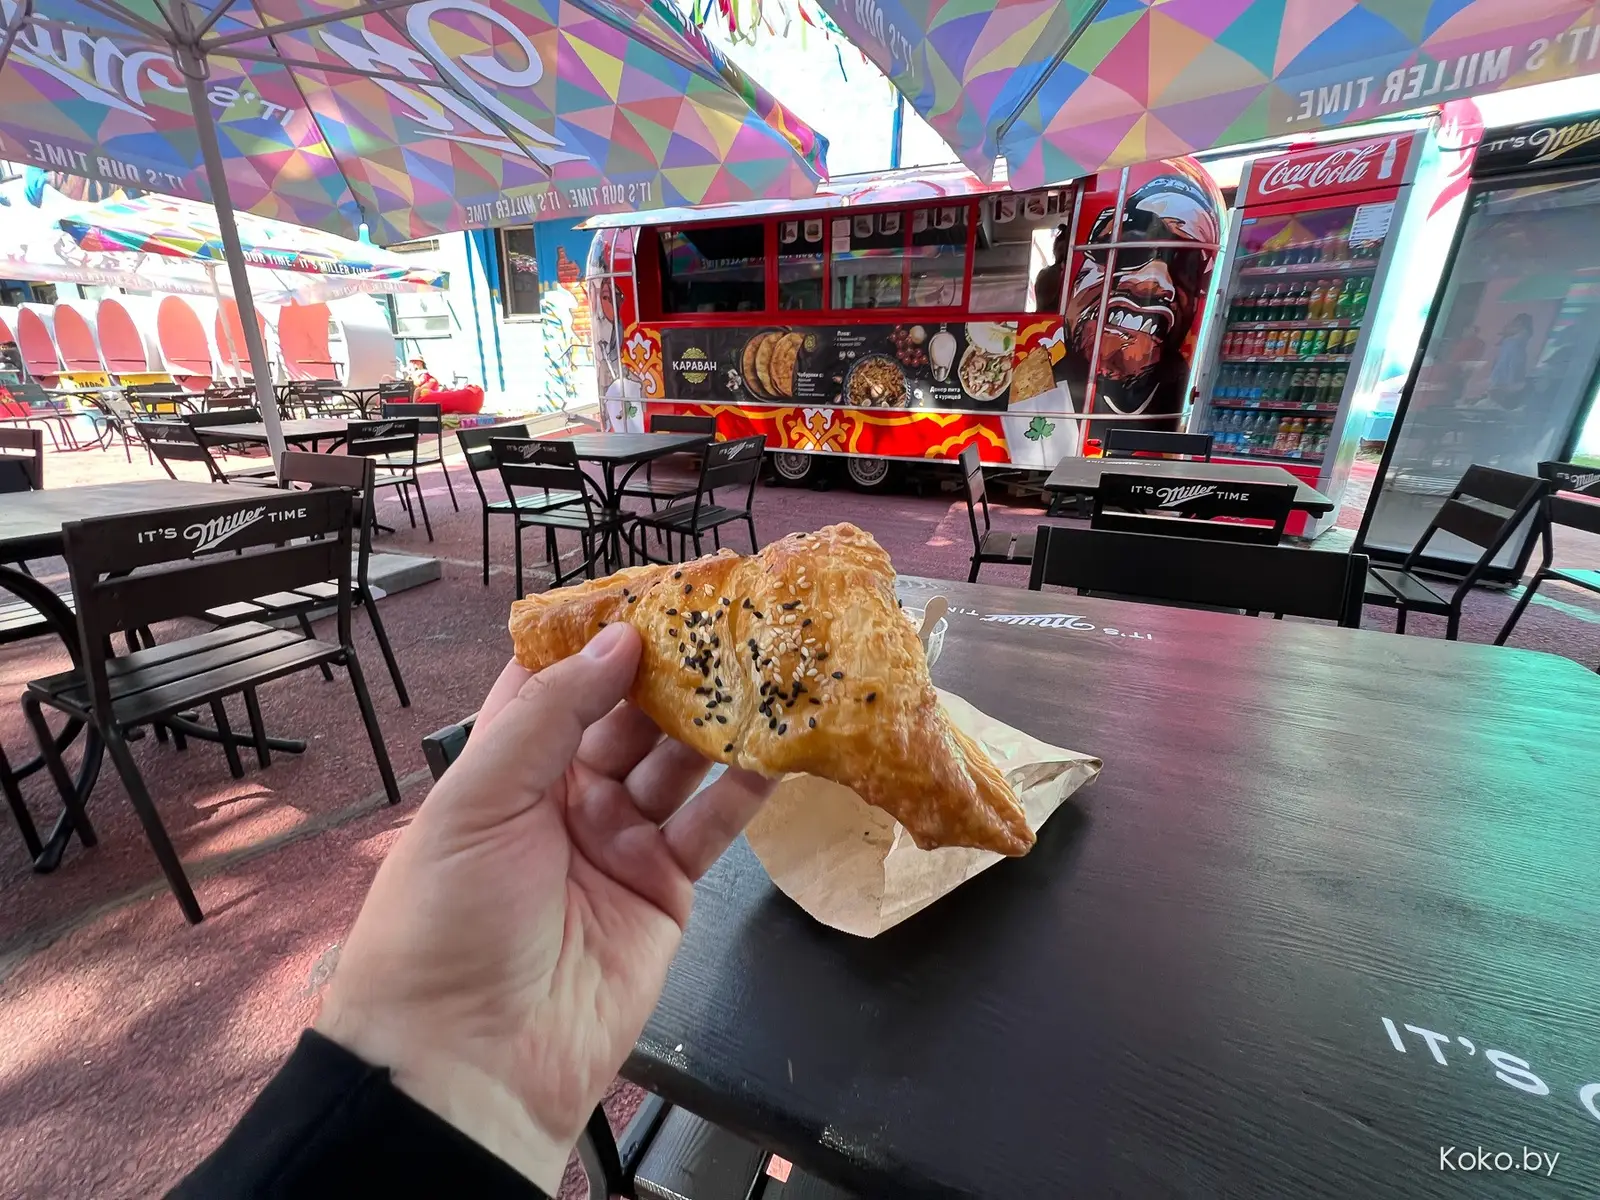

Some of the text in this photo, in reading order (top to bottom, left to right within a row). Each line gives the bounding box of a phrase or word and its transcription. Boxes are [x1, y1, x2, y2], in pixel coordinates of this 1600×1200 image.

[319, 261, 349, 275] MILLER
[672, 361, 717, 371] КАРАВАН
[1130, 484, 1250, 507] IT'S Miller TIME
[137, 505, 308, 554] IT'S Miller TIME
[947, 606, 979, 616] TIM
[1381, 1016, 1550, 1096] IT'S
